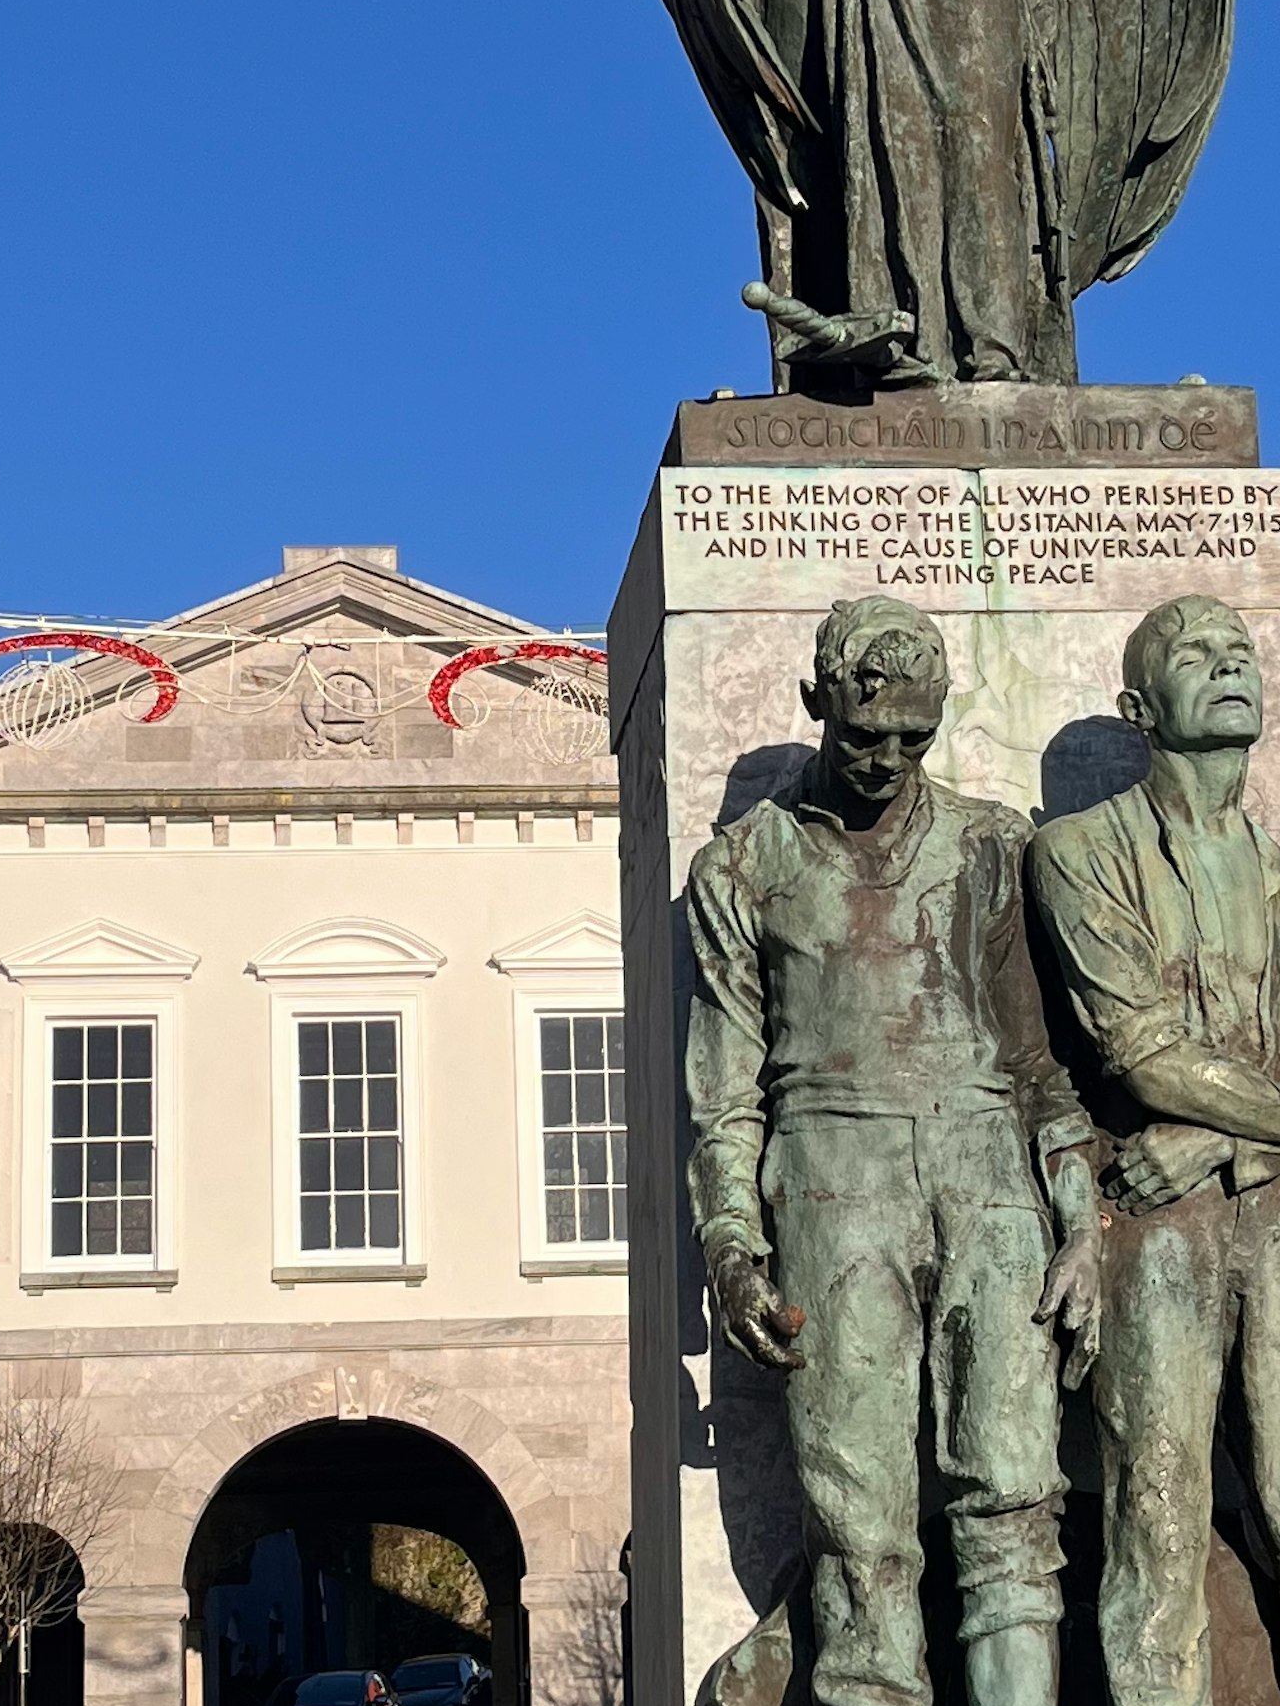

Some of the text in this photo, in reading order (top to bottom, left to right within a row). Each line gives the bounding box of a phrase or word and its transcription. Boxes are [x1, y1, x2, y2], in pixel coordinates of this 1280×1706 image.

[675, 484, 1278, 506] TO THE MEMORY OF ALL WHO PERISHED BY
[674, 511, 730, 532] THE
[742, 511, 861, 532] SINKING
[871, 512, 907, 532] OF
[918, 512, 971, 533] THE
[983, 512, 1127, 533] LUSITANIA
[705, 537, 1256, 558] AND IN THE CAUSE OF UNIVERSAL AND
[876, 564, 1095, 585] LASTING PEACE
